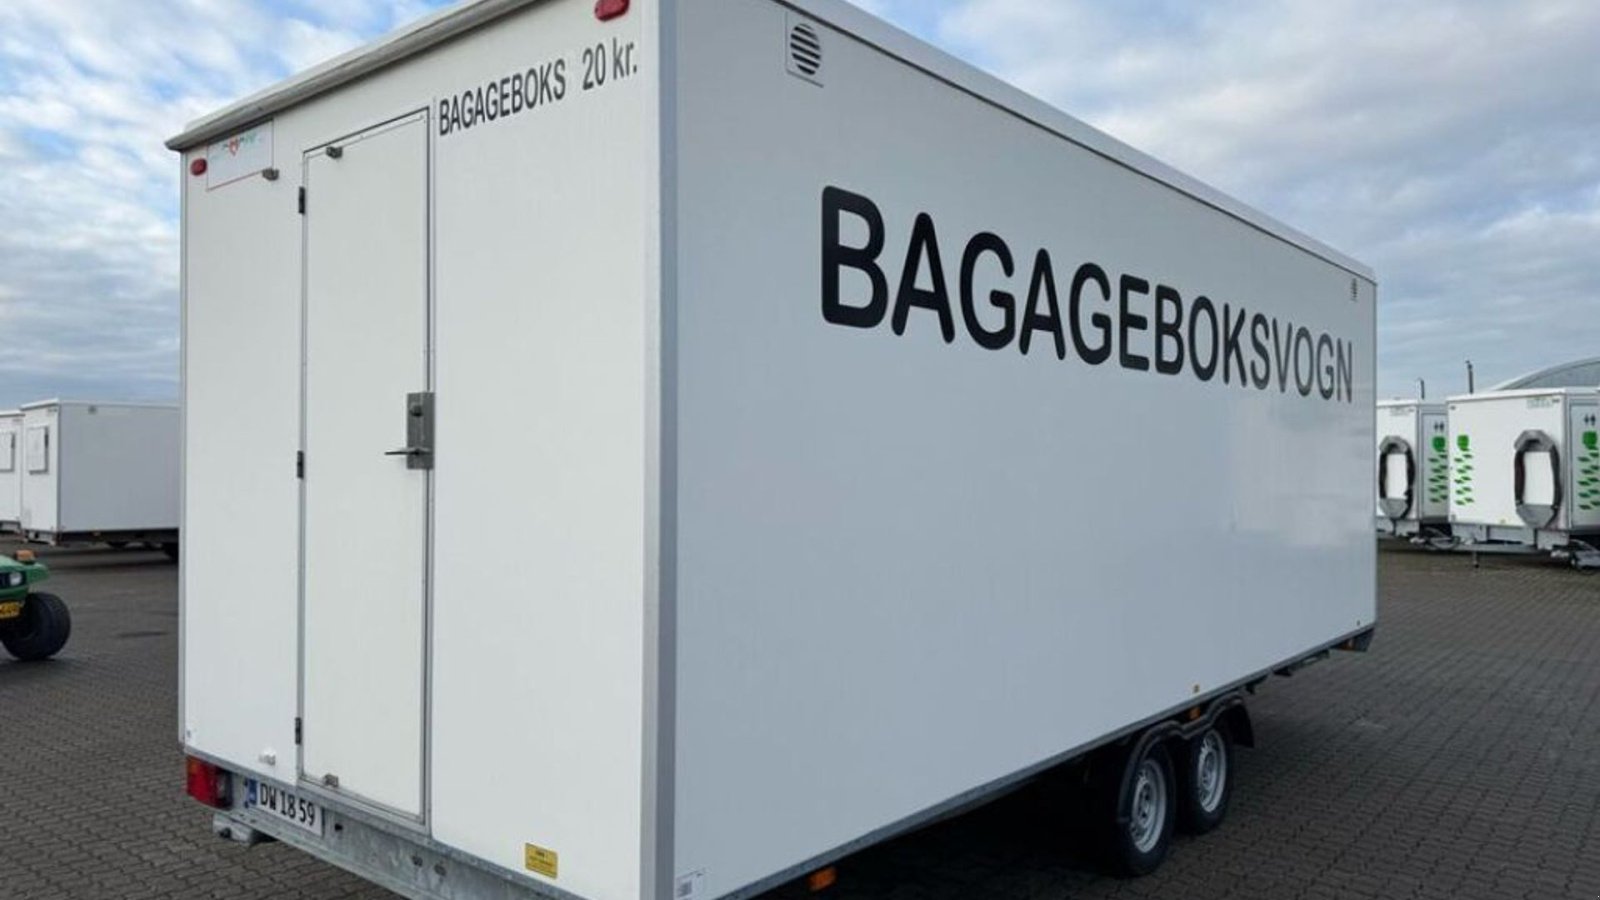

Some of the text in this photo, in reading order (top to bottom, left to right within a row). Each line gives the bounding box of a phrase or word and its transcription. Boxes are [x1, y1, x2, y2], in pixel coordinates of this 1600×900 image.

[439, 37, 638, 136] BAGAGEBOKS 20 kr.
[821, 185, 1353, 403] BAGAGEBOKSVOGN
